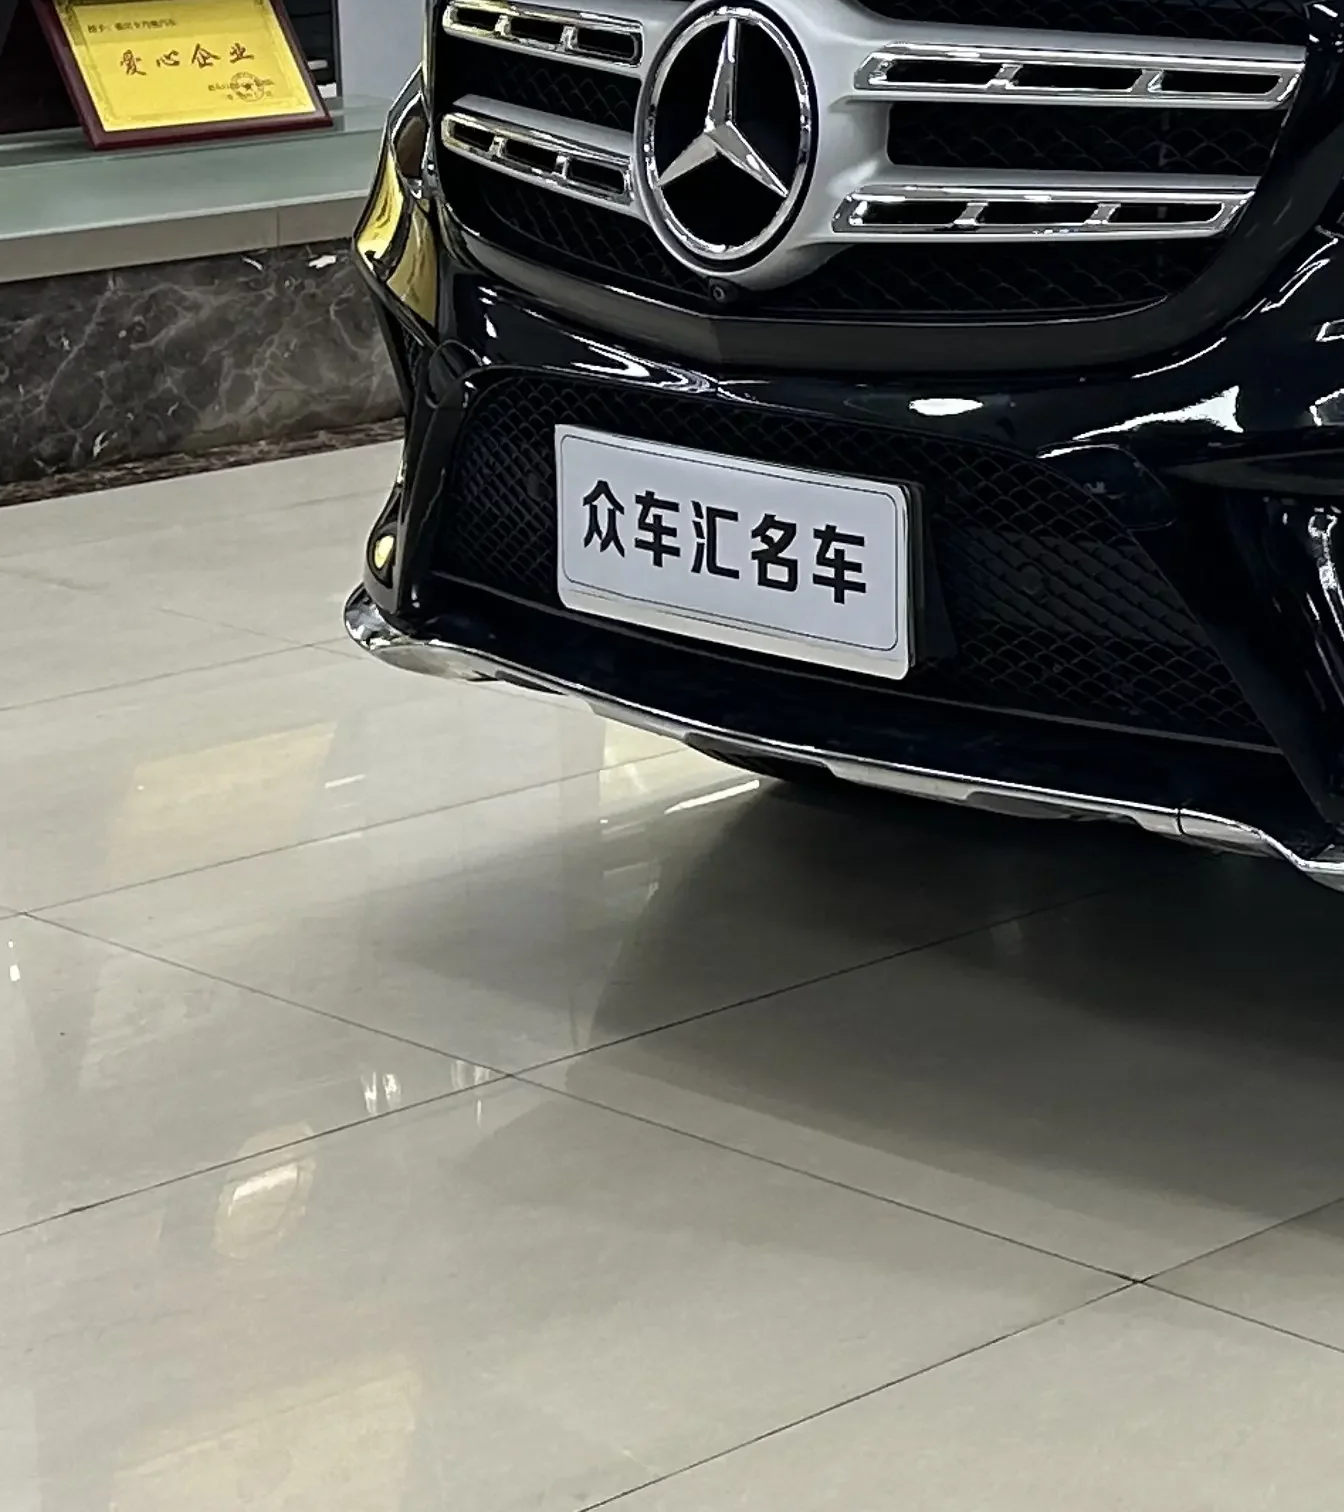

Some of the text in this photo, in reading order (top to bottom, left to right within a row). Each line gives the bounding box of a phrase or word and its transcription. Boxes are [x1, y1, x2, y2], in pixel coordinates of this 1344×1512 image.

[120, 43, 254, 76] 爱心企业
[582, 480, 867, 605] 众车汇名车
